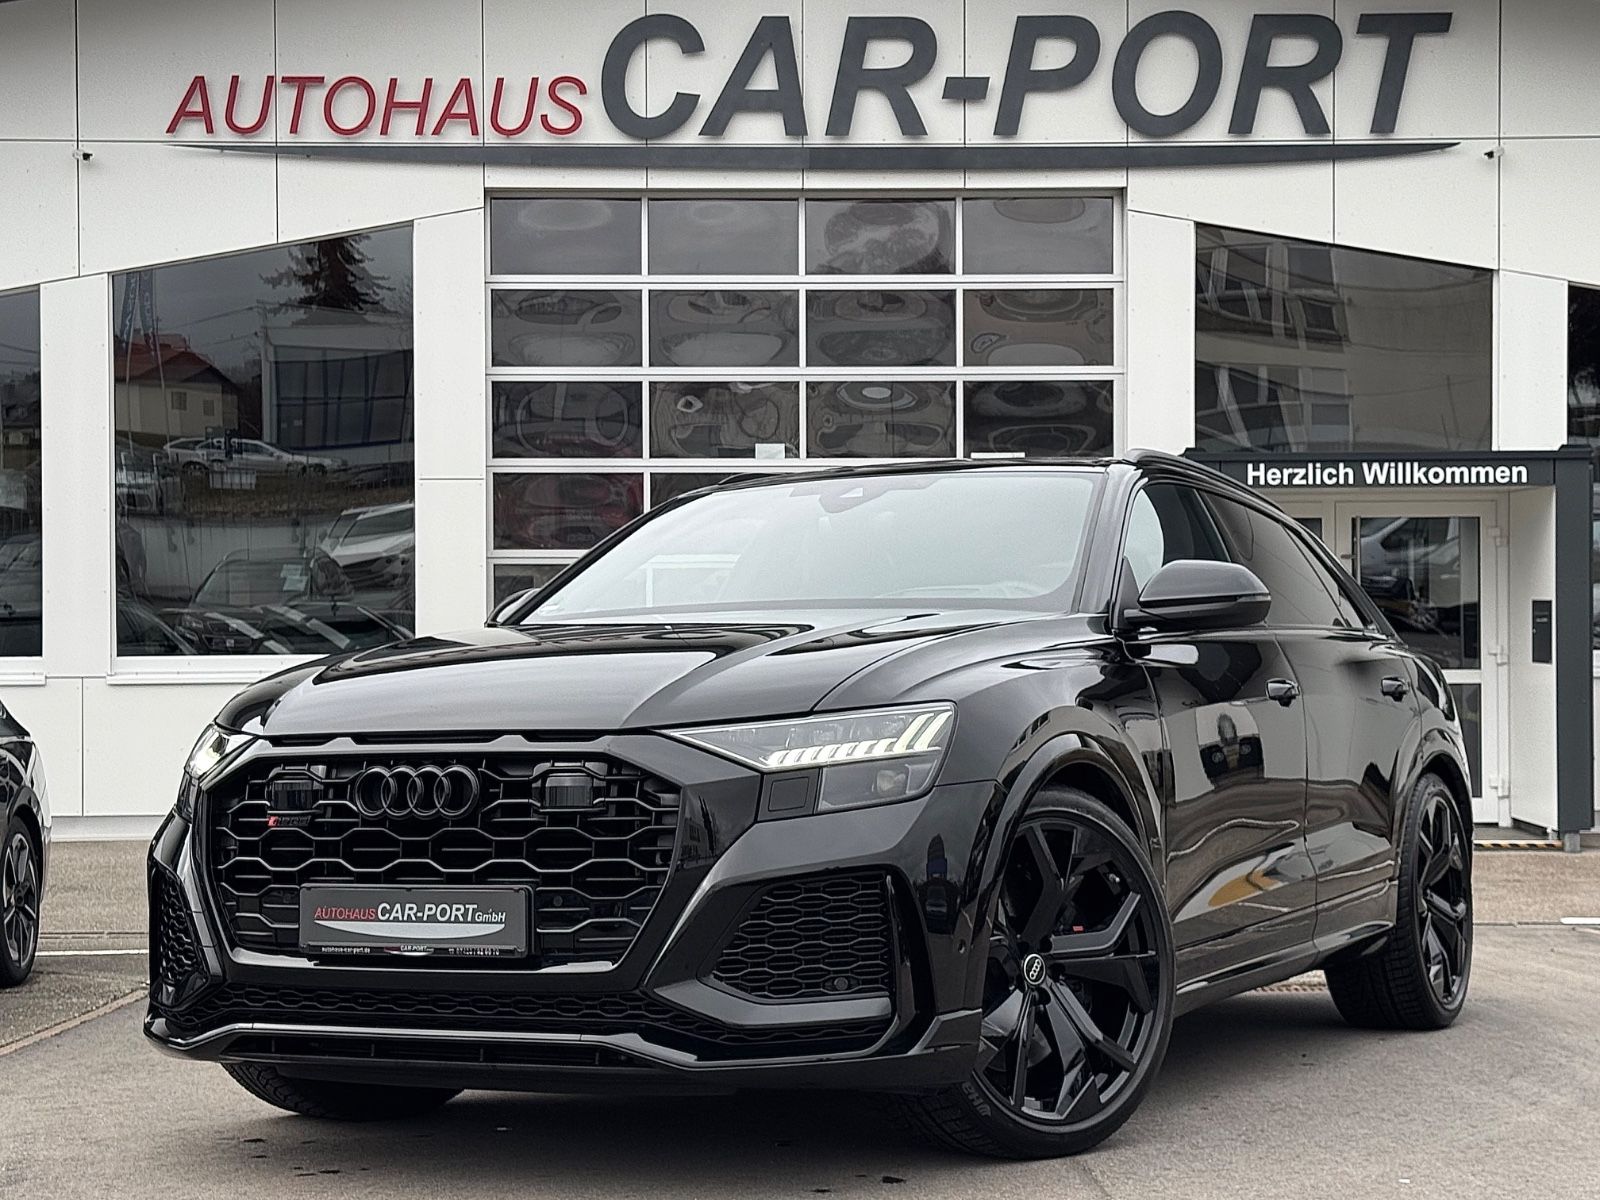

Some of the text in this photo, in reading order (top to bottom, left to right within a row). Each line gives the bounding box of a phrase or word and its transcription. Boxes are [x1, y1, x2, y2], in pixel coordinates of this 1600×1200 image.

[166, 10, 1453, 139] AUTOHAUS CAR-PORT
[1246, 462, 1528, 485] Herzlich Willkommen
[314, 903, 506, 923] AUTOHAUS CAR-PORT GmbH
